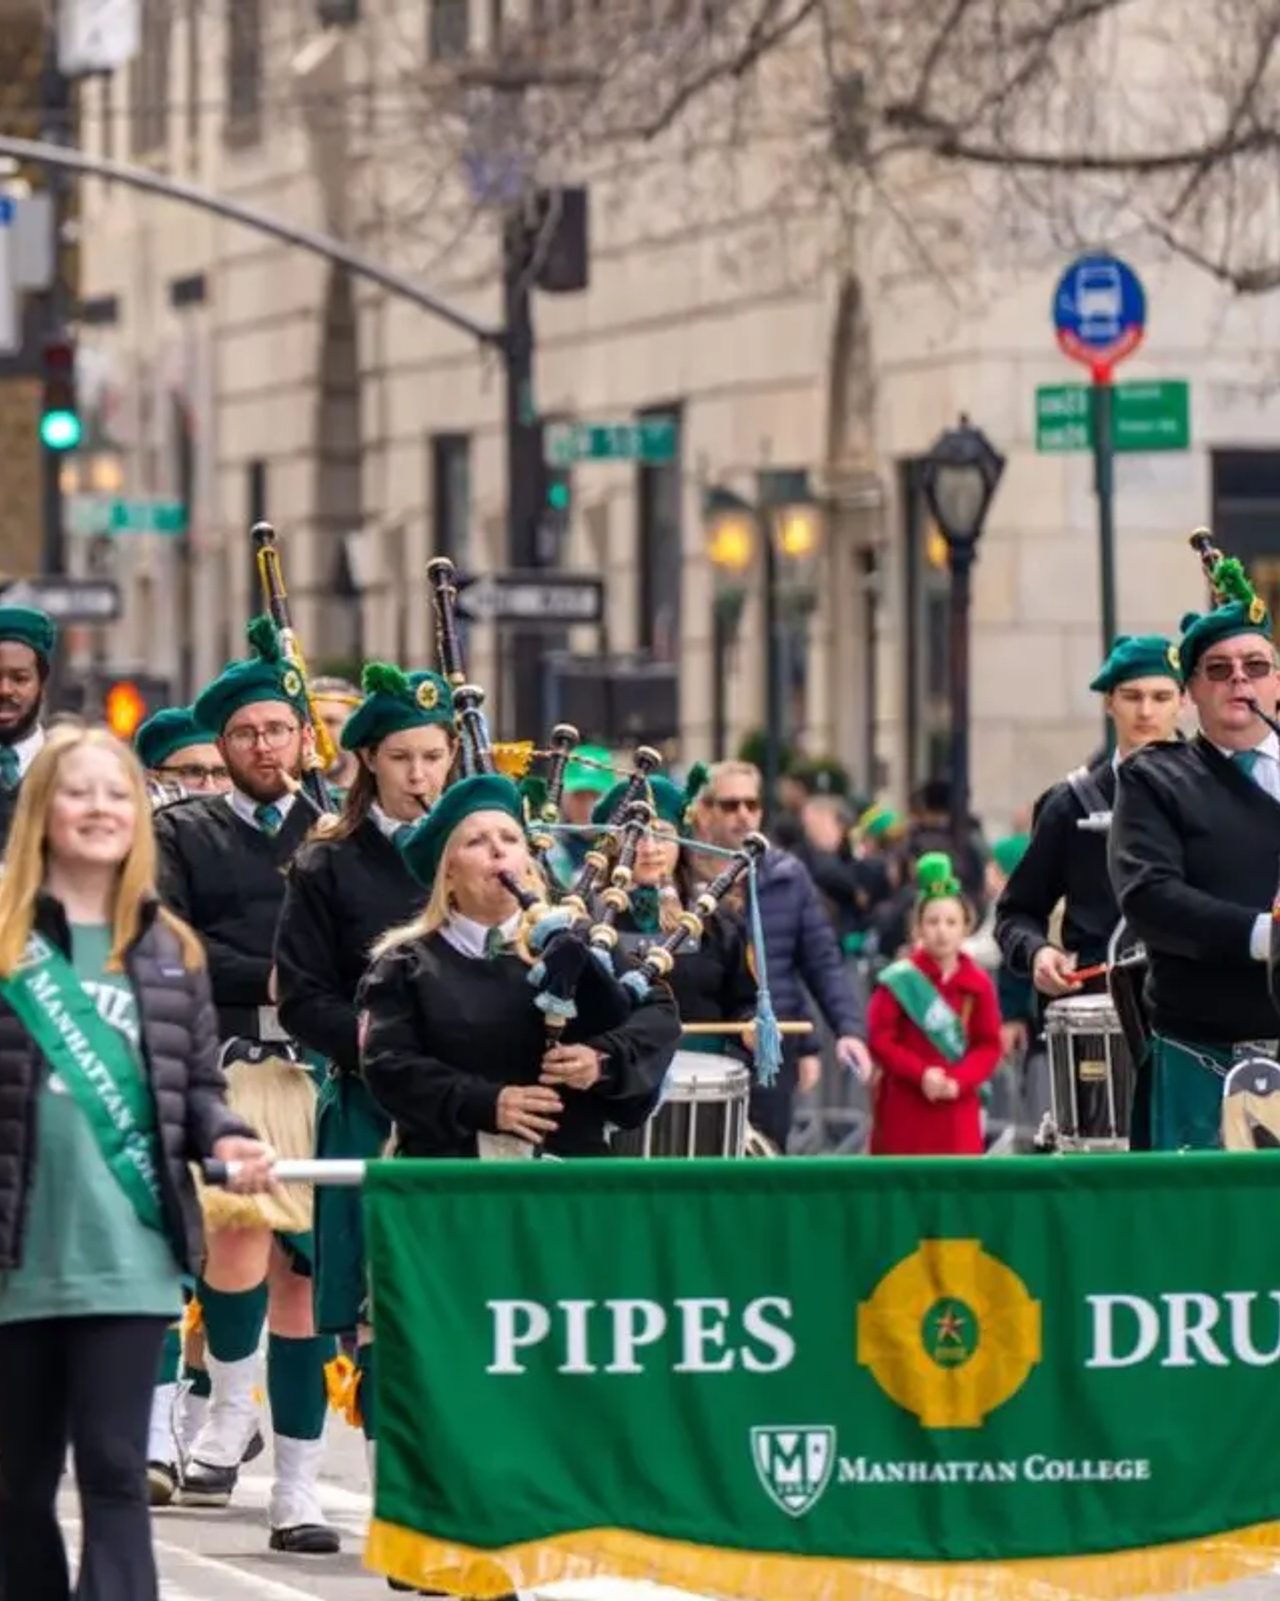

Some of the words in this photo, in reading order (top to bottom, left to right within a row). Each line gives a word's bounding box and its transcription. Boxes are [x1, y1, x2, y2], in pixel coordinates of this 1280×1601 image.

[24, 969, 137, 1131] MANHATTAN
[485, 1296, 796, 1374] PIPES
[1084, 1291, 1280, 1368] DRU
[838, 1456, 1017, 1482] MANHATTAN
[1024, 1454, 1151, 1481] COLLEGE
